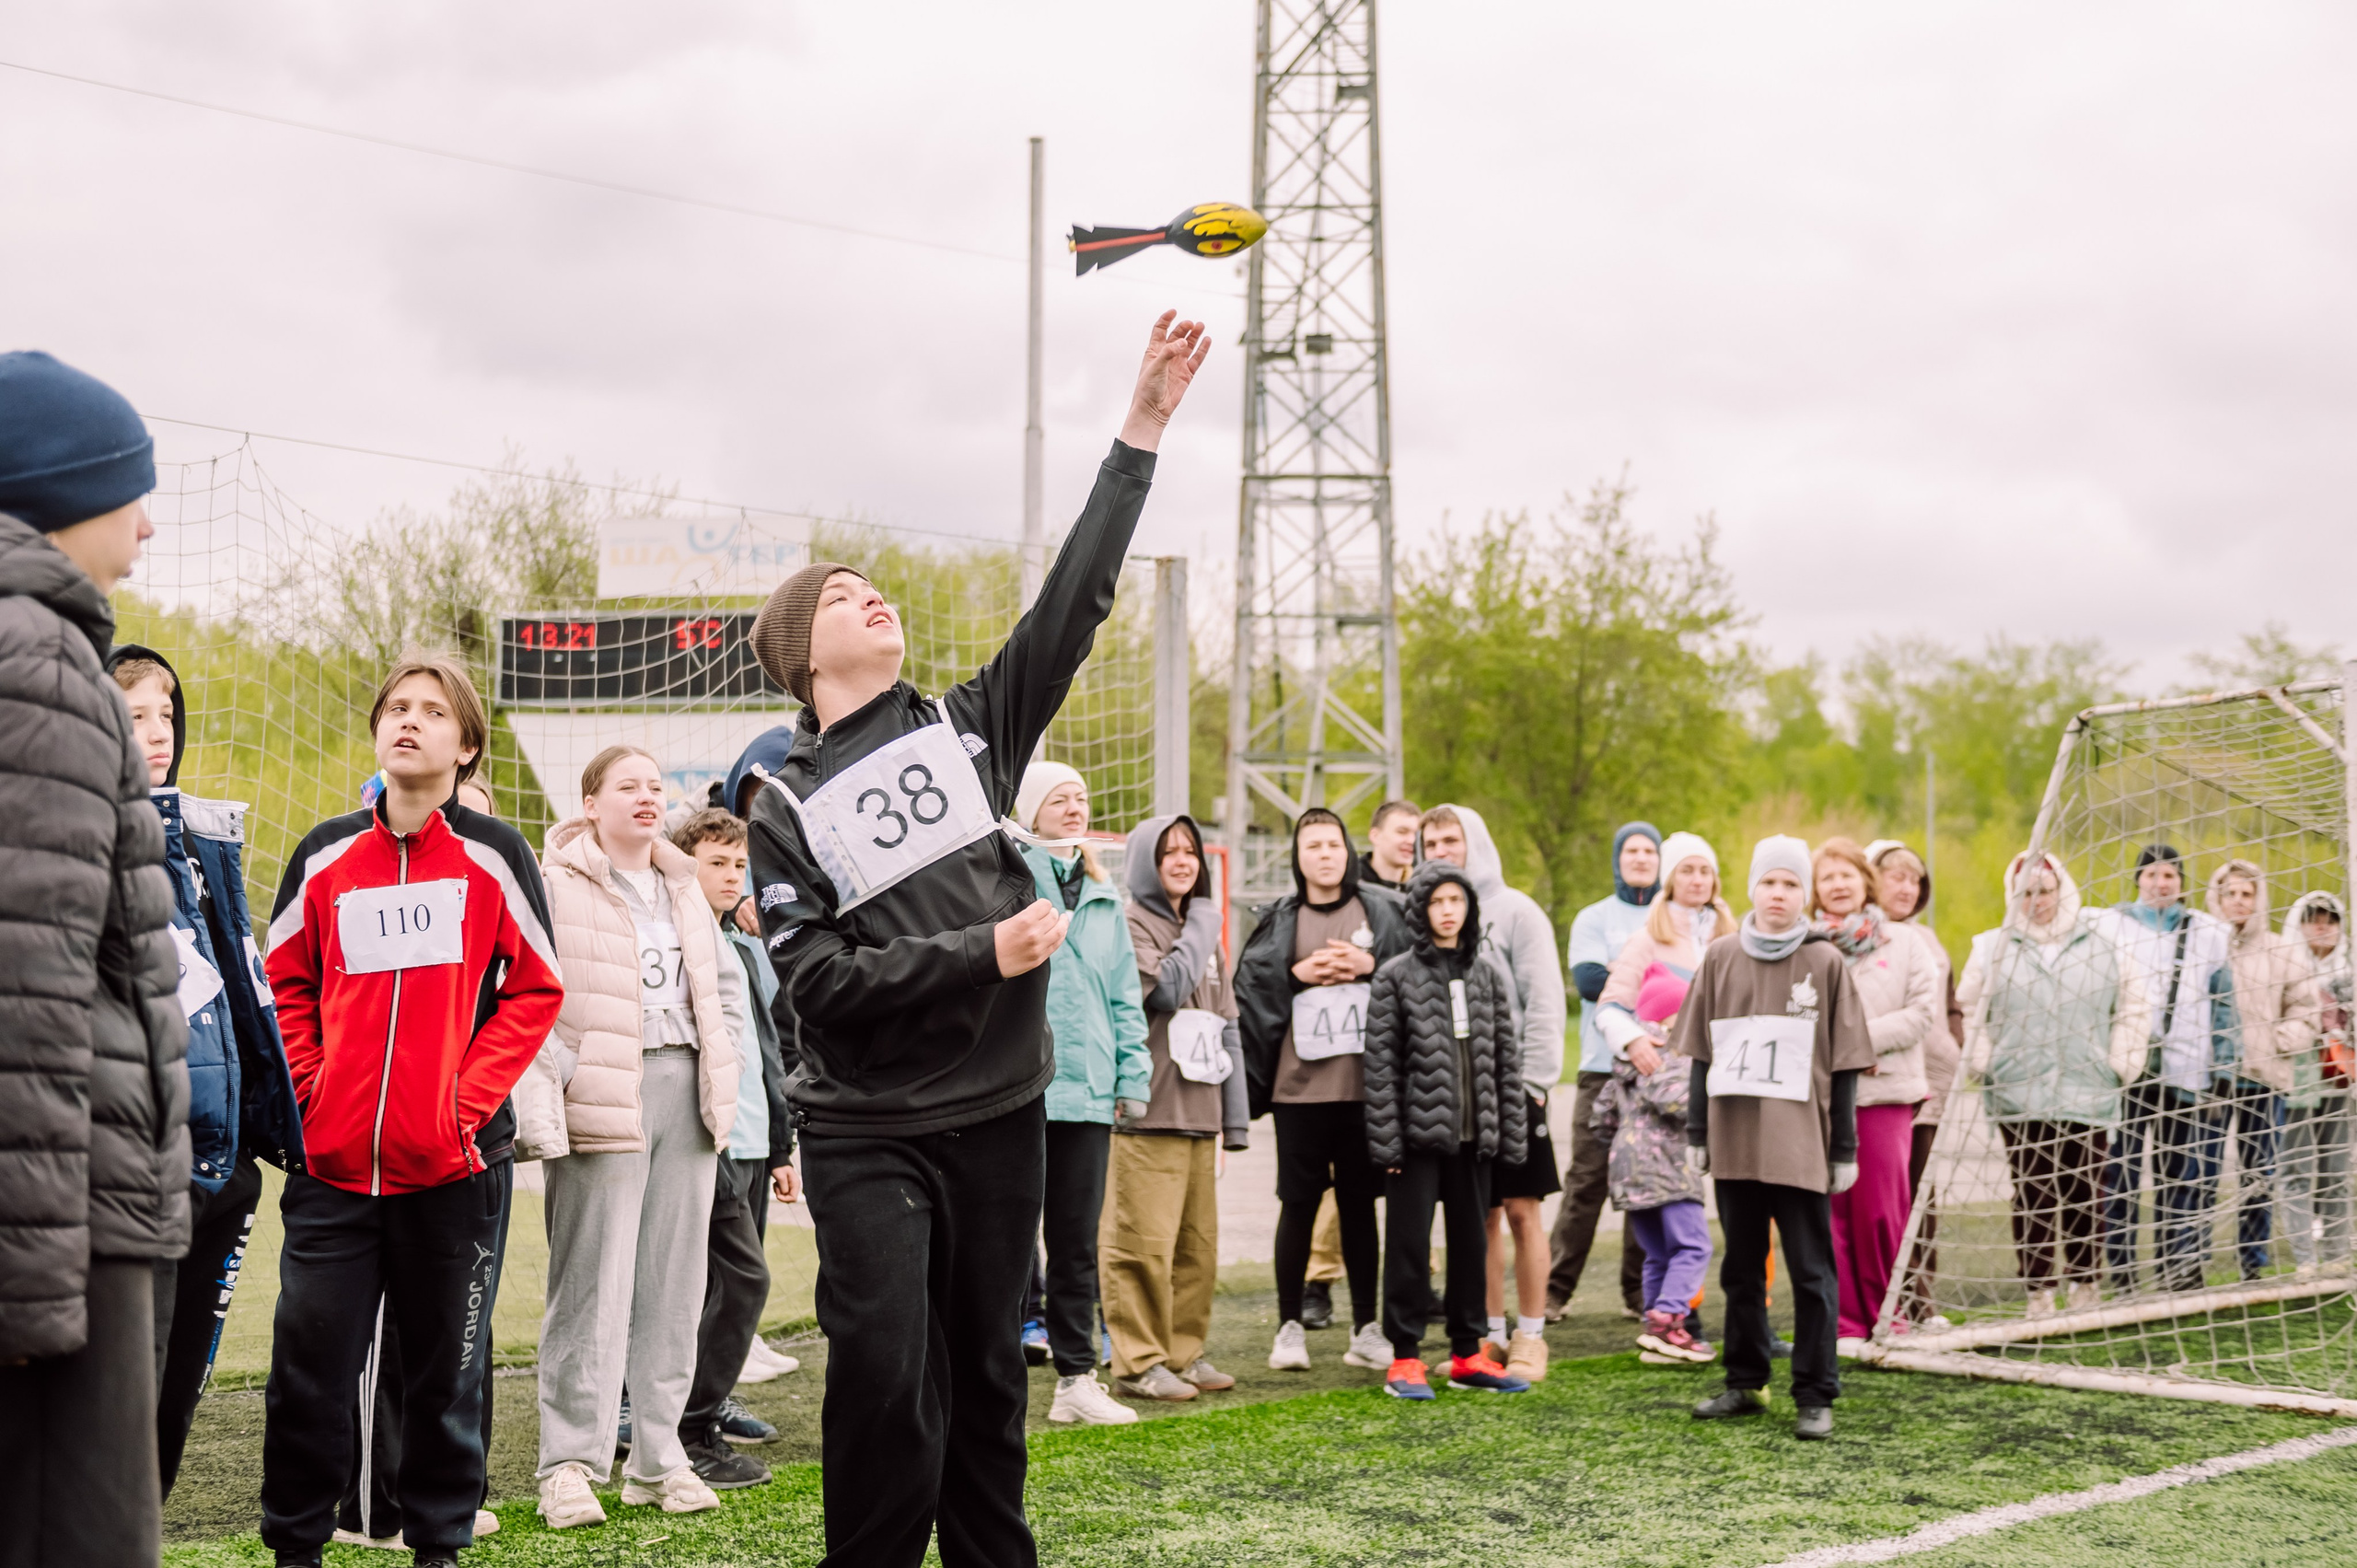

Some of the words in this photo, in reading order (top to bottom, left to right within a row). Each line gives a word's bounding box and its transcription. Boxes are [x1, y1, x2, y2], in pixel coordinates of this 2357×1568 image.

[856, 763, 948, 849] 38
[761, 884, 778, 896] THE
[377, 904, 431, 937] 110
[641, 947, 684, 989] 37
[1313, 1005, 1366, 1045] 44
[1725, 1040, 1782, 1086] 41
[460, 1281, 483, 1371] JORDAN
